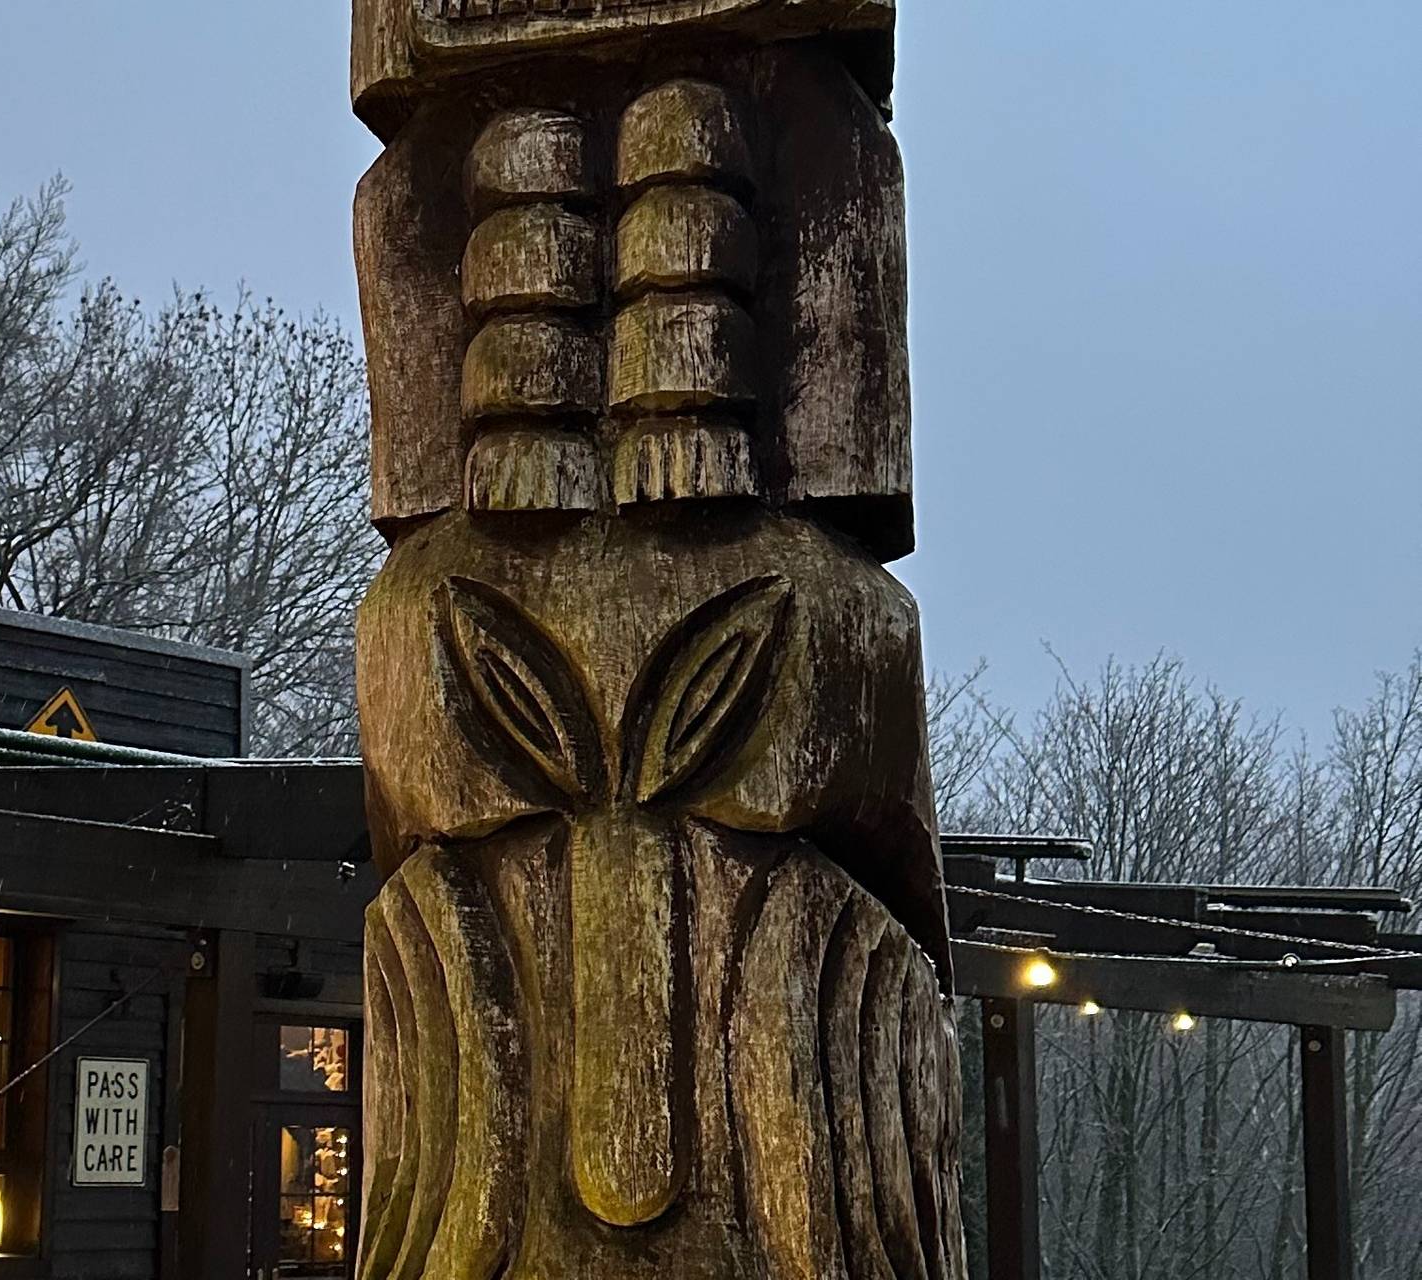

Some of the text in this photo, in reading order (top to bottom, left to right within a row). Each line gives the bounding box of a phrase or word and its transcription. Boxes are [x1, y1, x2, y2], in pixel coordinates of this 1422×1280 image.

[86, 1070, 139, 1100] PASS
[85, 1108, 138, 1136] WITH
[84, 1144, 138, 1172] CARE
